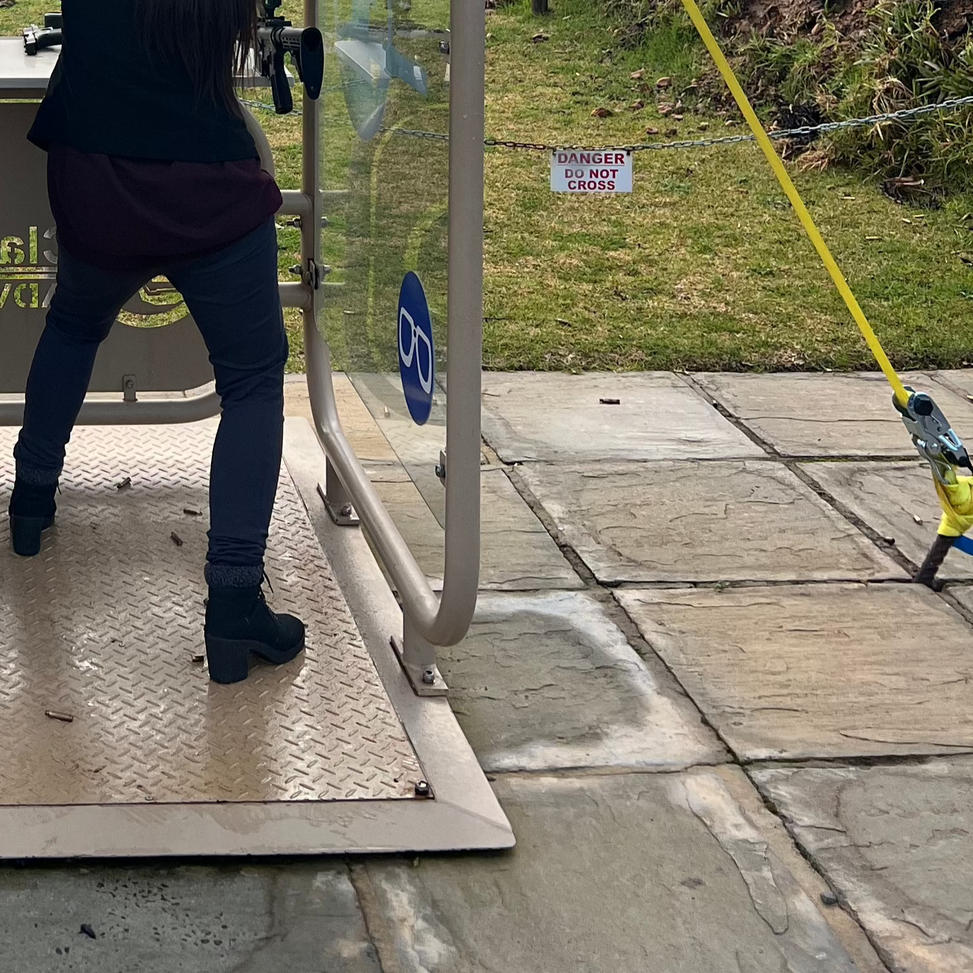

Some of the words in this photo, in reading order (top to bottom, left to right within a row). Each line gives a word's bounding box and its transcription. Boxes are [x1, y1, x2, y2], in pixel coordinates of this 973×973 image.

[557, 152, 625, 165] DANGER
[564, 168, 585, 179] DO
[589, 168, 619, 179] NOT
[567, 180, 616, 191] CROSS
